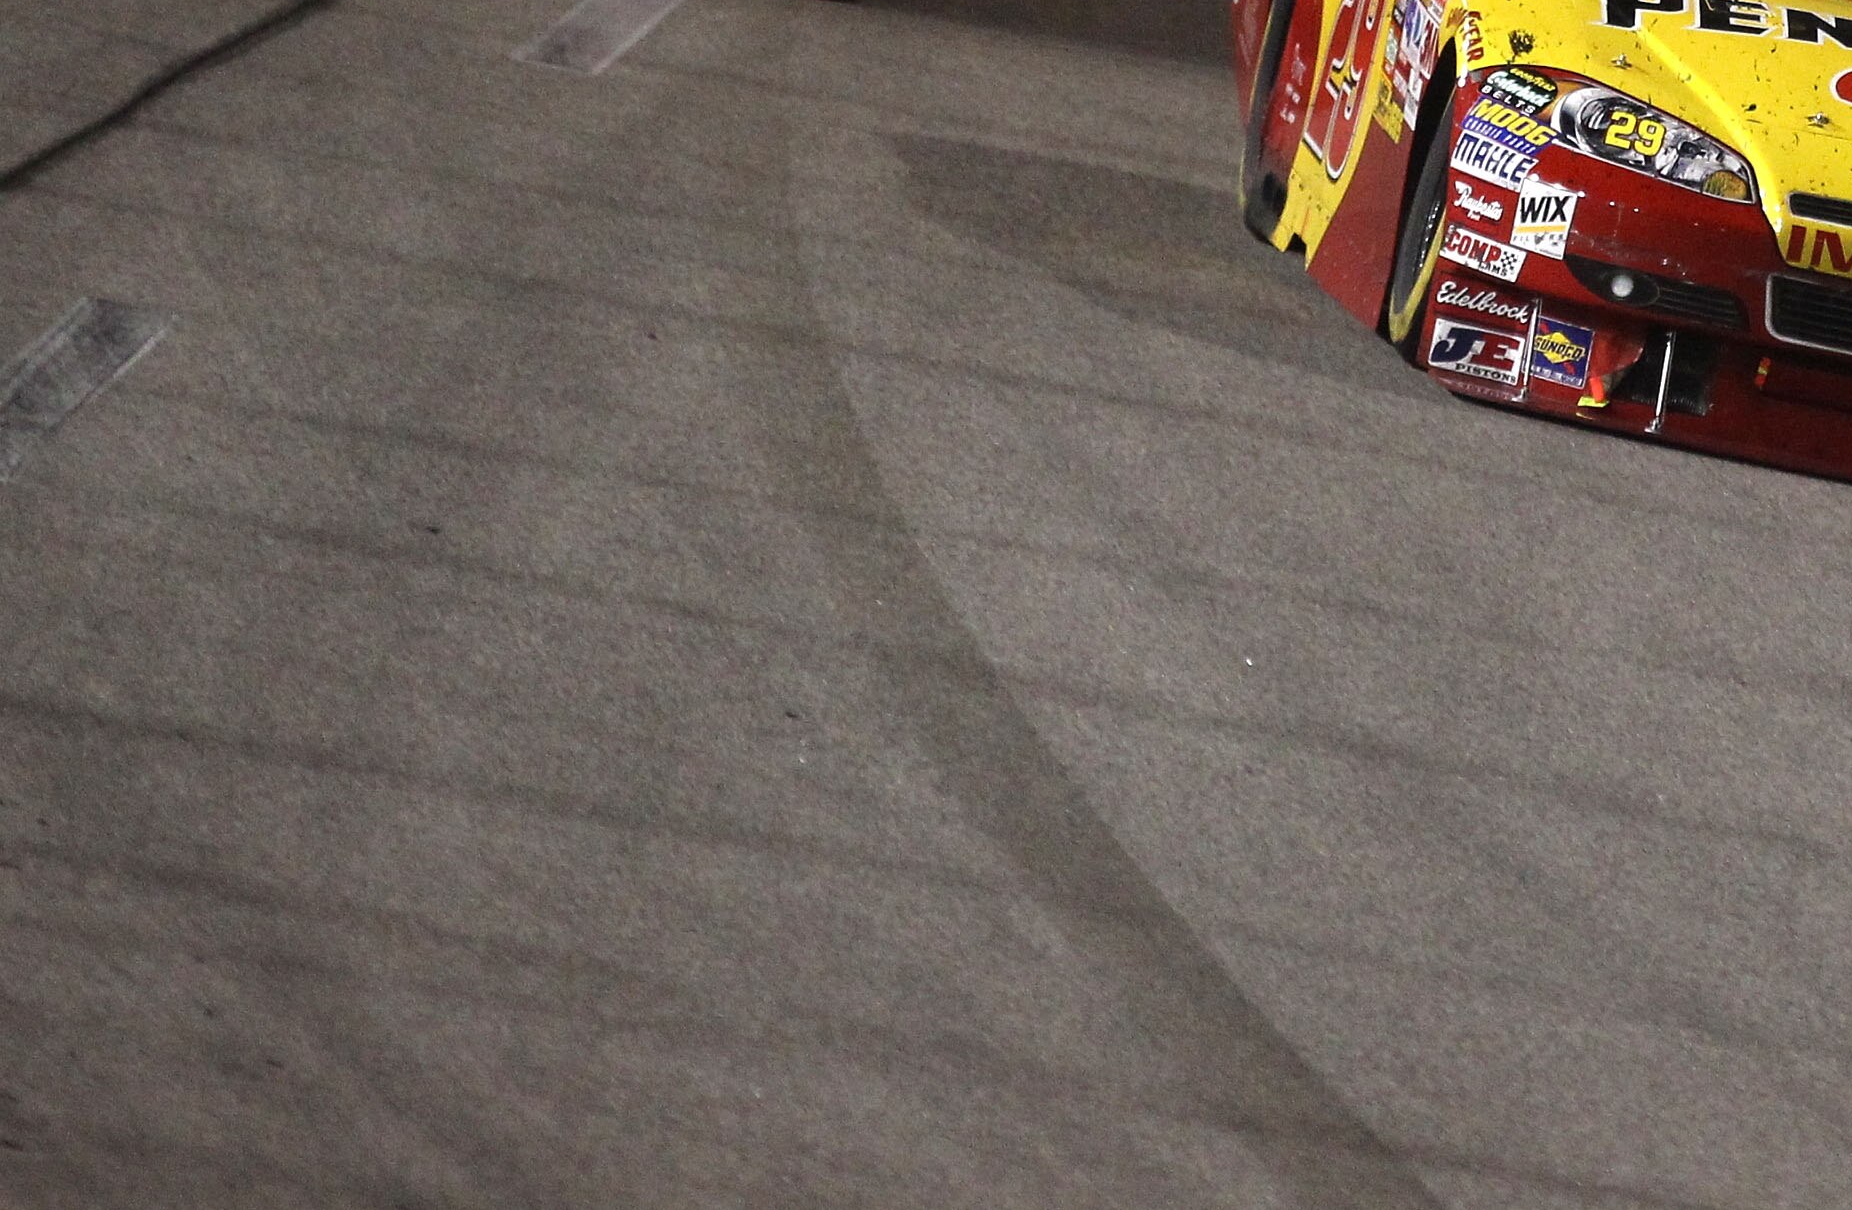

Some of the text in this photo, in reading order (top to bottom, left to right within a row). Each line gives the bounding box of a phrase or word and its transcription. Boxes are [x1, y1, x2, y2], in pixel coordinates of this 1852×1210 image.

[1480, 84, 1537, 115] BELTS
[1471, 98, 1558, 147] MOOG
[1605, 110, 1666, 157] 29
[1454, 132, 1535, 183] MAHLE
[1520, 195, 1571, 224] WIX
[1445, 230, 1502, 263] COMP
[1436, 280, 1529, 324] Edelbrock
[1430, 327, 1521, 372] JE
[1534, 335, 1586, 362] SUNOCO
[1455, 362, 1517, 384] PISTONS
